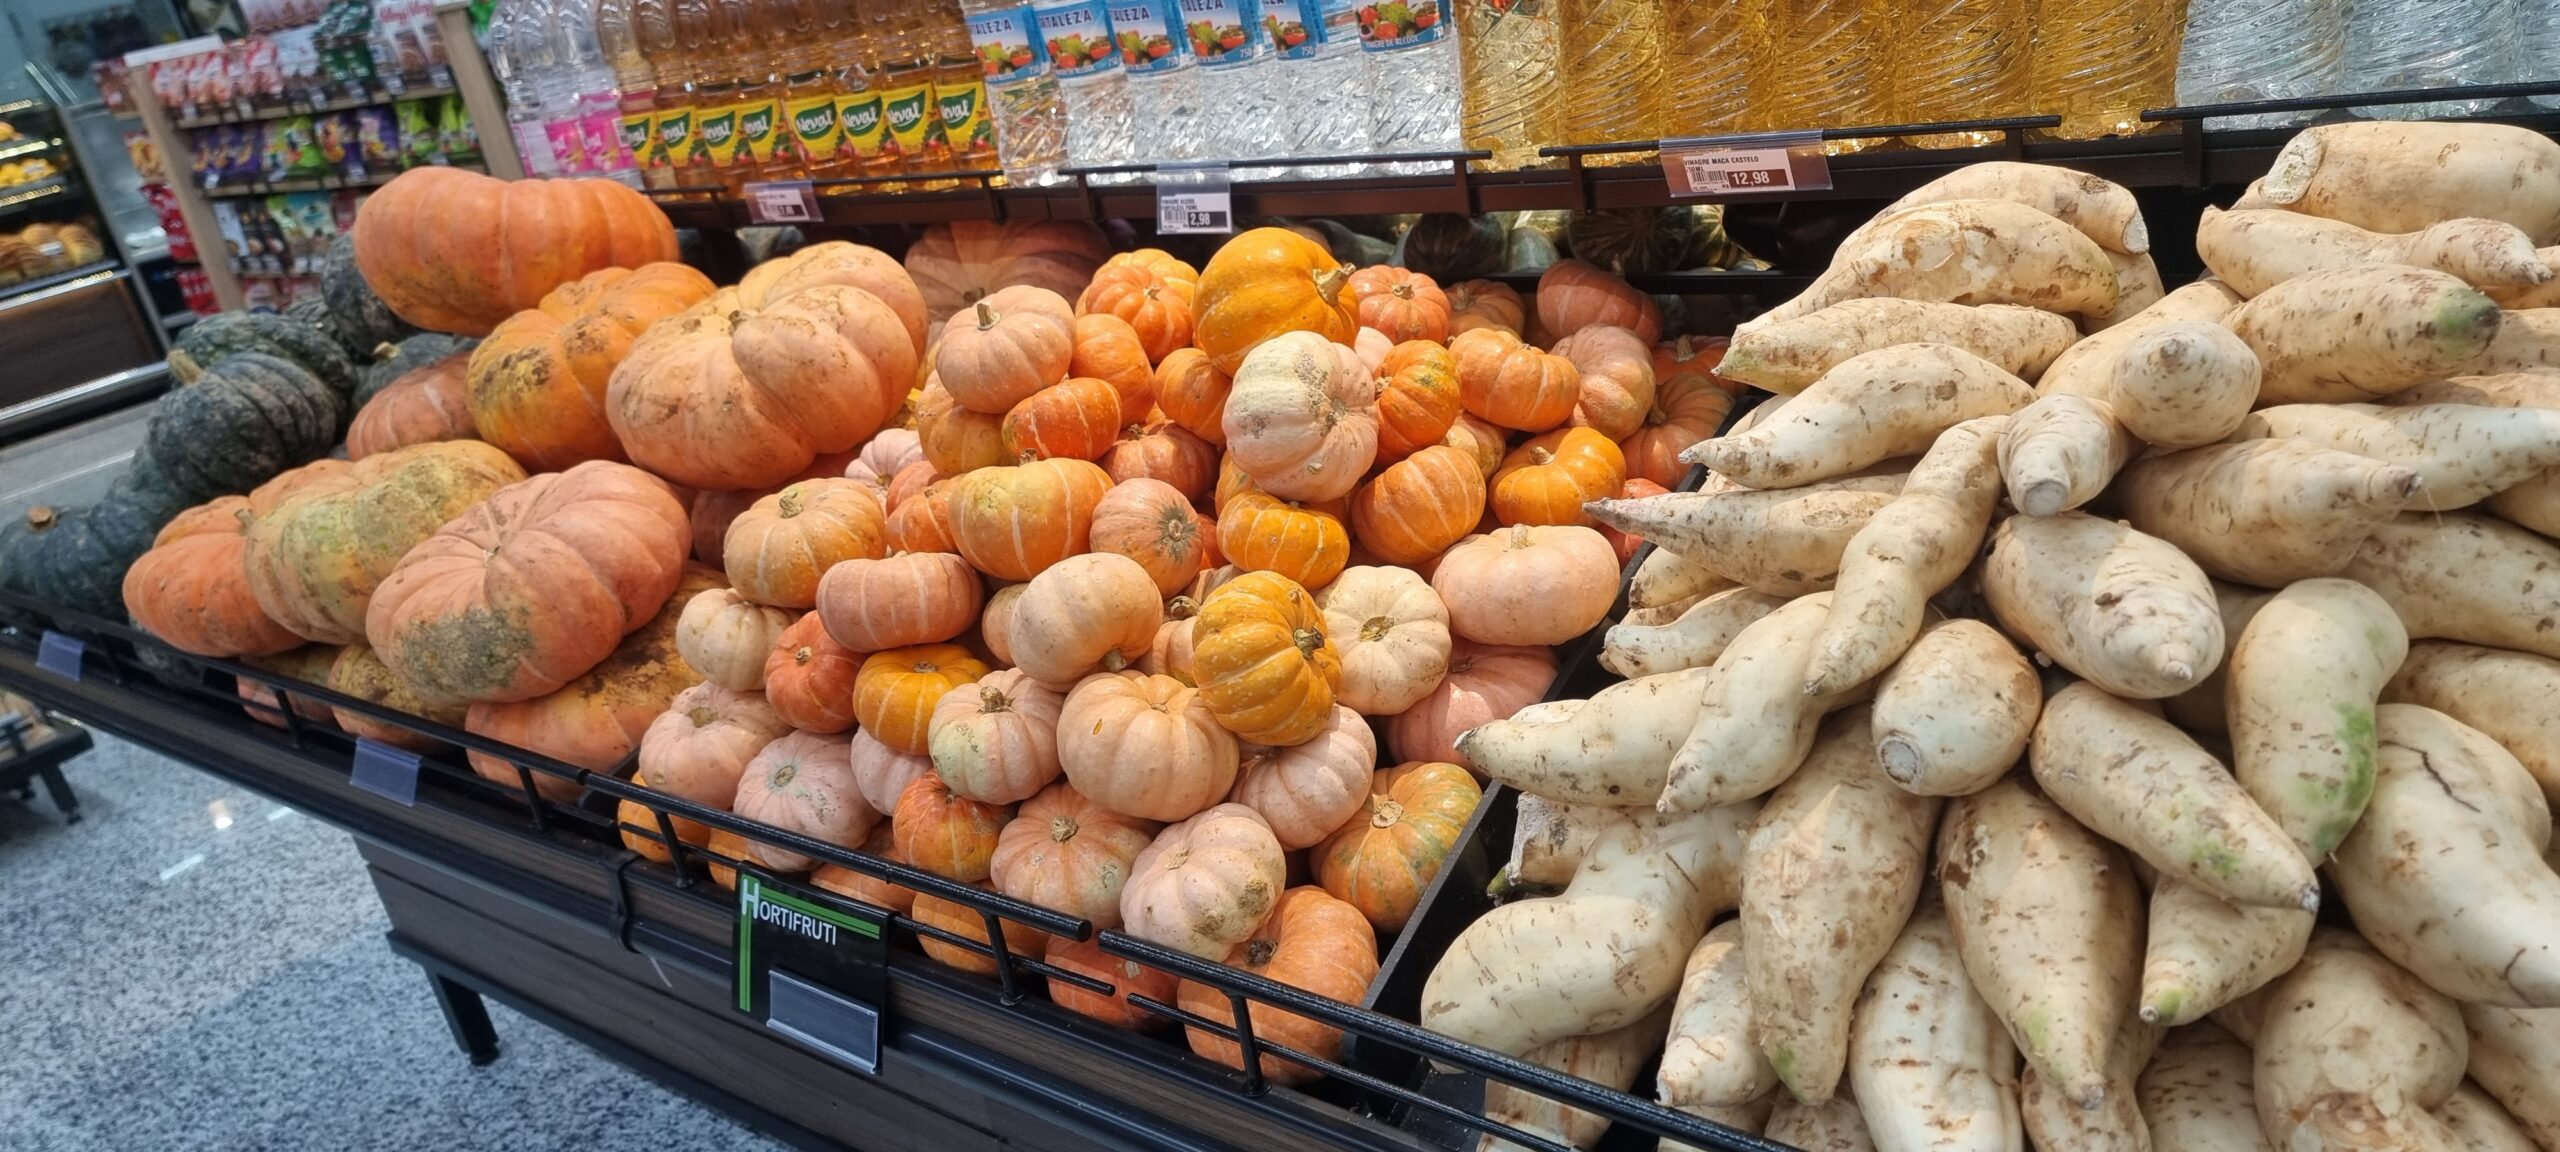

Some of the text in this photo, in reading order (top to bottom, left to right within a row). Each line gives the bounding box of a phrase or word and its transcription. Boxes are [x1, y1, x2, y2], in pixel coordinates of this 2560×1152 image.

[797, 110, 834, 131] Neval
[844, 107, 879, 128] Neval
[888, 102, 921, 123] Neval
[1685, 158, 1710, 166] VINAGRE
[1732, 171, 1770, 186] 12,98
[1190, 213, 1210, 226] 2,98
[741, 878, 836, 946] HORTIFRUTI
